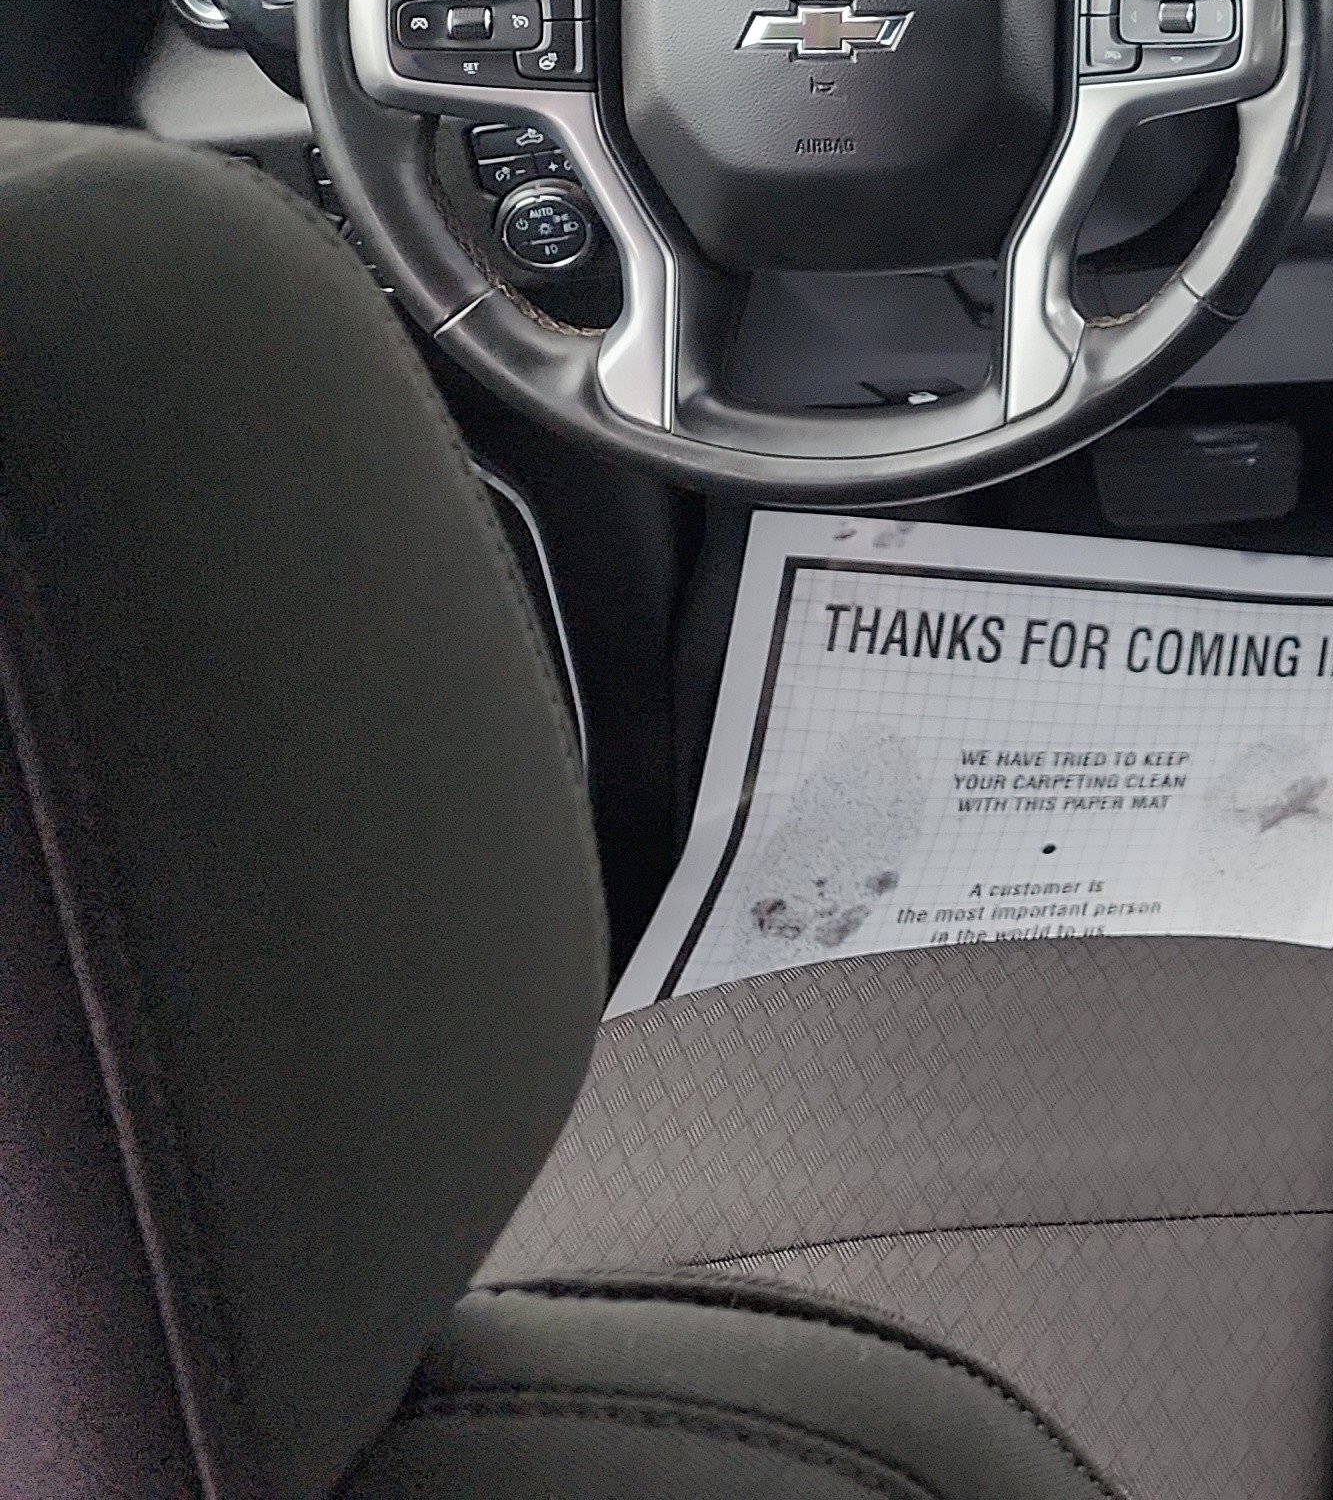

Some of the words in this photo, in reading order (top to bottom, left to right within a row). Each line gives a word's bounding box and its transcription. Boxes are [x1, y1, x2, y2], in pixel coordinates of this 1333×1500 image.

[463, 62, 480, 72] SET
[795, 138, 856, 153] AIRBAG
[529, 207, 554, 219] AUTO
[825, 603, 1005, 663] THANKS
[1020, 618, 1111, 671] FOR
[1125, 625, 1302, 677] COMING
[961, 749, 990, 766] WE
[997, 750, 1047, 766] HAVE
[1052, 751, 1107, 766] TRIED
[1114, 751, 1137, 766] TO
[1143, 751, 1190, 766] KEEP
[954, 773, 1007, 790] YOUR
[1013, 774, 1120, 790] CARPETING
[1125, 774, 1187, 788] CLEAN
[958, 797, 1008, 812] WITH
[1014, 796, 1057, 812] THIS
[1063, 796, 1124, 811] PAPER
[1130, 795, 1172, 810] MAT
[968, 883, 982, 898] A
[989, 881, 1082, 897] customer
[1088, 879, 1105, 893] is
[897, 908, 928, 924] the
[934, 905, 985, 923] most
[991, 902, 1088, 922] important
[1094, 901, 1162, 918] person
[930, 929, 949, 944] in
[957, 928, 988, 945] the
[996, 924, 1051, 941] world
[1057, 924, 1076, 938] to
